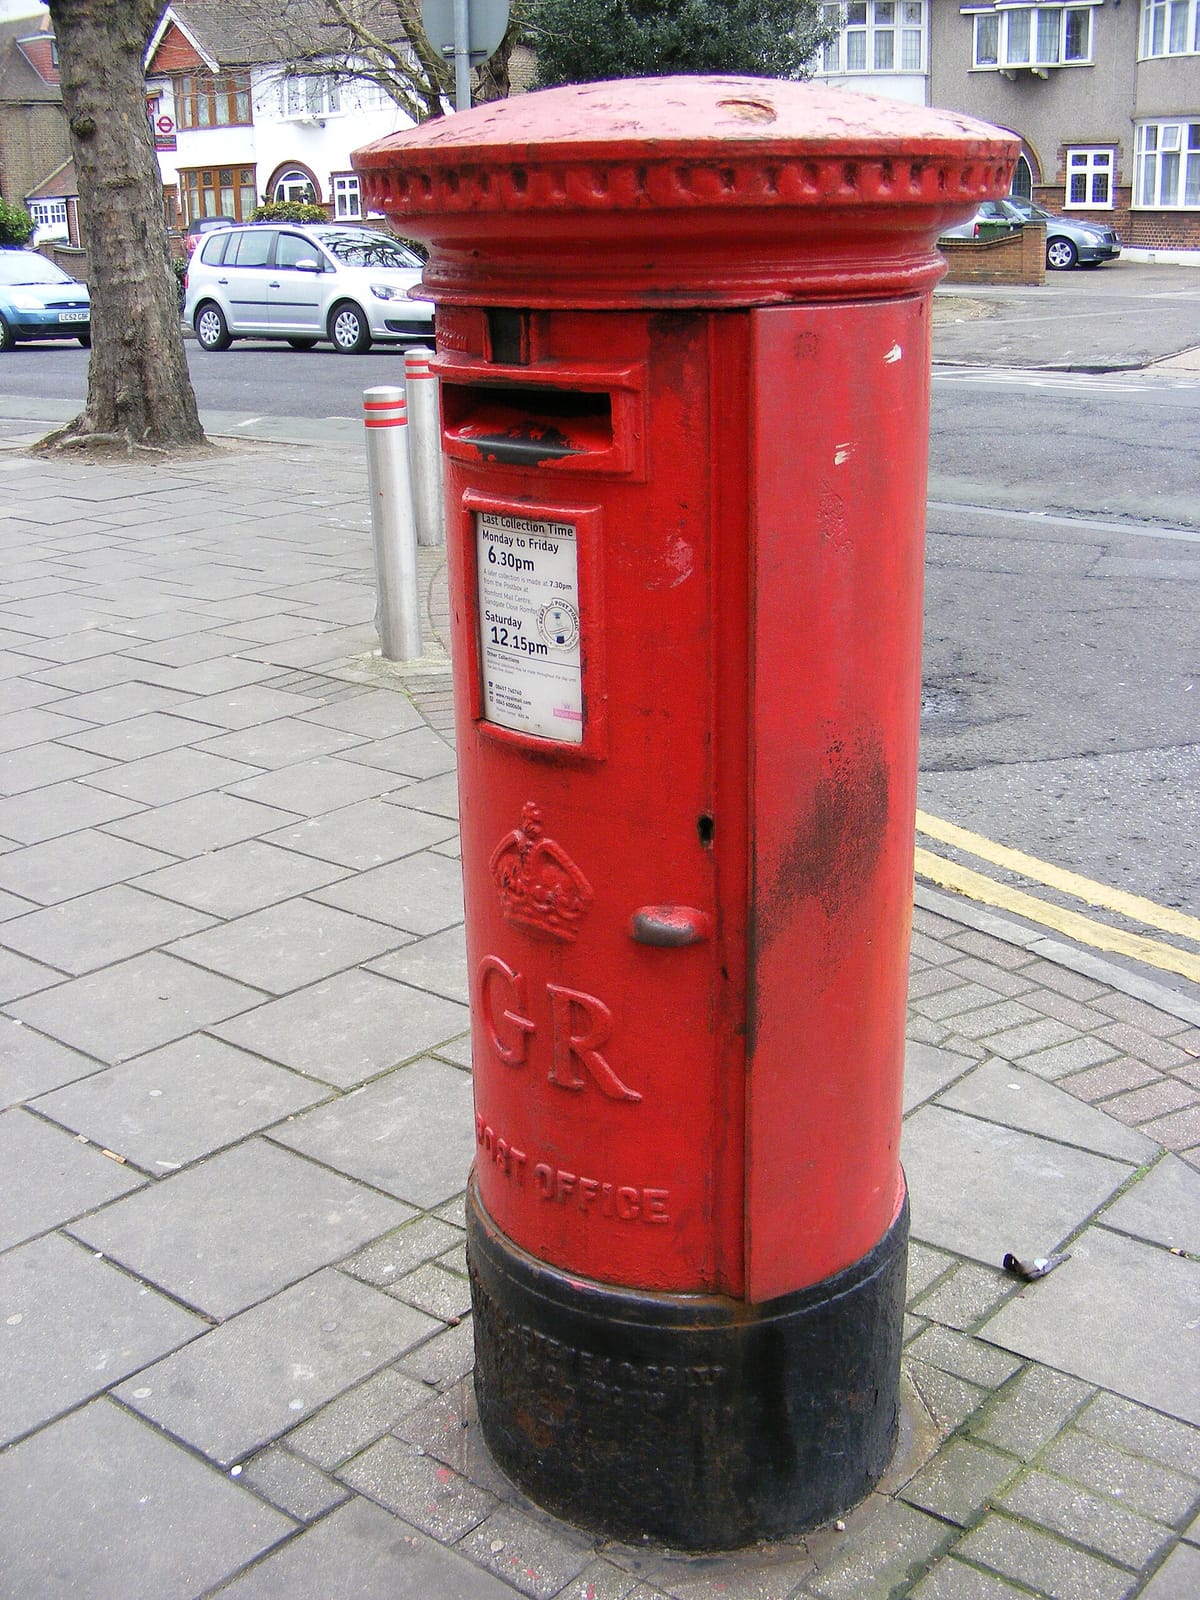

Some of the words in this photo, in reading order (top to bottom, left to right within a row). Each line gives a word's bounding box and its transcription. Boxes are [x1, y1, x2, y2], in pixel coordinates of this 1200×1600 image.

[482, 513, 499, 526] Last
[501, 518, 545, 533] Collection
[548, 523, 574, 537] Time
[482, 530, 514, 547] Monday
[516, 537, 526, 548] to
[529, 538, 559, 554] Friday
[488, 545, 535, 571] 6.30pm
[549, 581, 573, 591] 7.30pm
[485, 610, 522, 630] Saturday
[491, 625, 548, 655] 12.15pm
[535, 1163, 670, 1223] OFFICE
